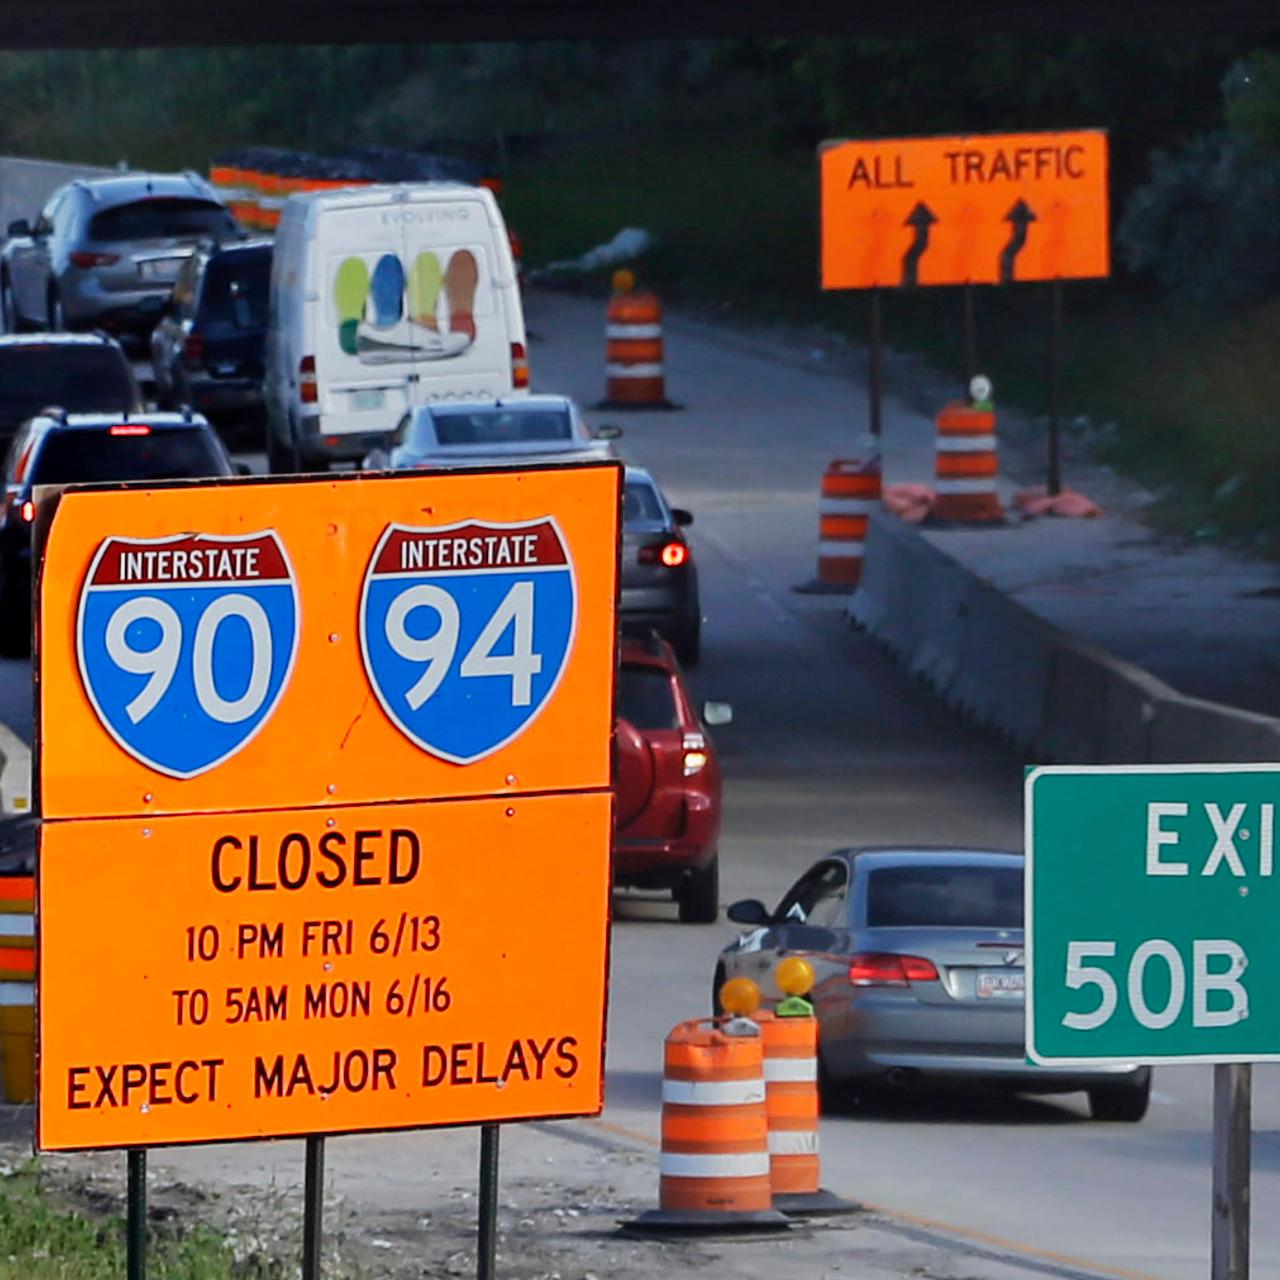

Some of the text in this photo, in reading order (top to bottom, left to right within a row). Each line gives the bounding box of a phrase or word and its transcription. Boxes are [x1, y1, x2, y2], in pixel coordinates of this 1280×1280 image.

[847, 145, 1085, 190] ALL TRAFFIC
[119, 548, 260, 581] INTERSTATE
[401, 535, 539, 570] INTERSTATE
[105, 594, 273, 725] 90
[385, 581, 542, 712] 94
[211, 829, 421, 893] CLOSED
[187, 912, 441, 962] 10 PM FRI 6/13
[173, 974, 451, 1025] TO 5AM MON 6/16
[1061, 939, 1249, 1030] 50B
[67, 1036, 578, 1110] EXPECT MAJOR DELAYS
